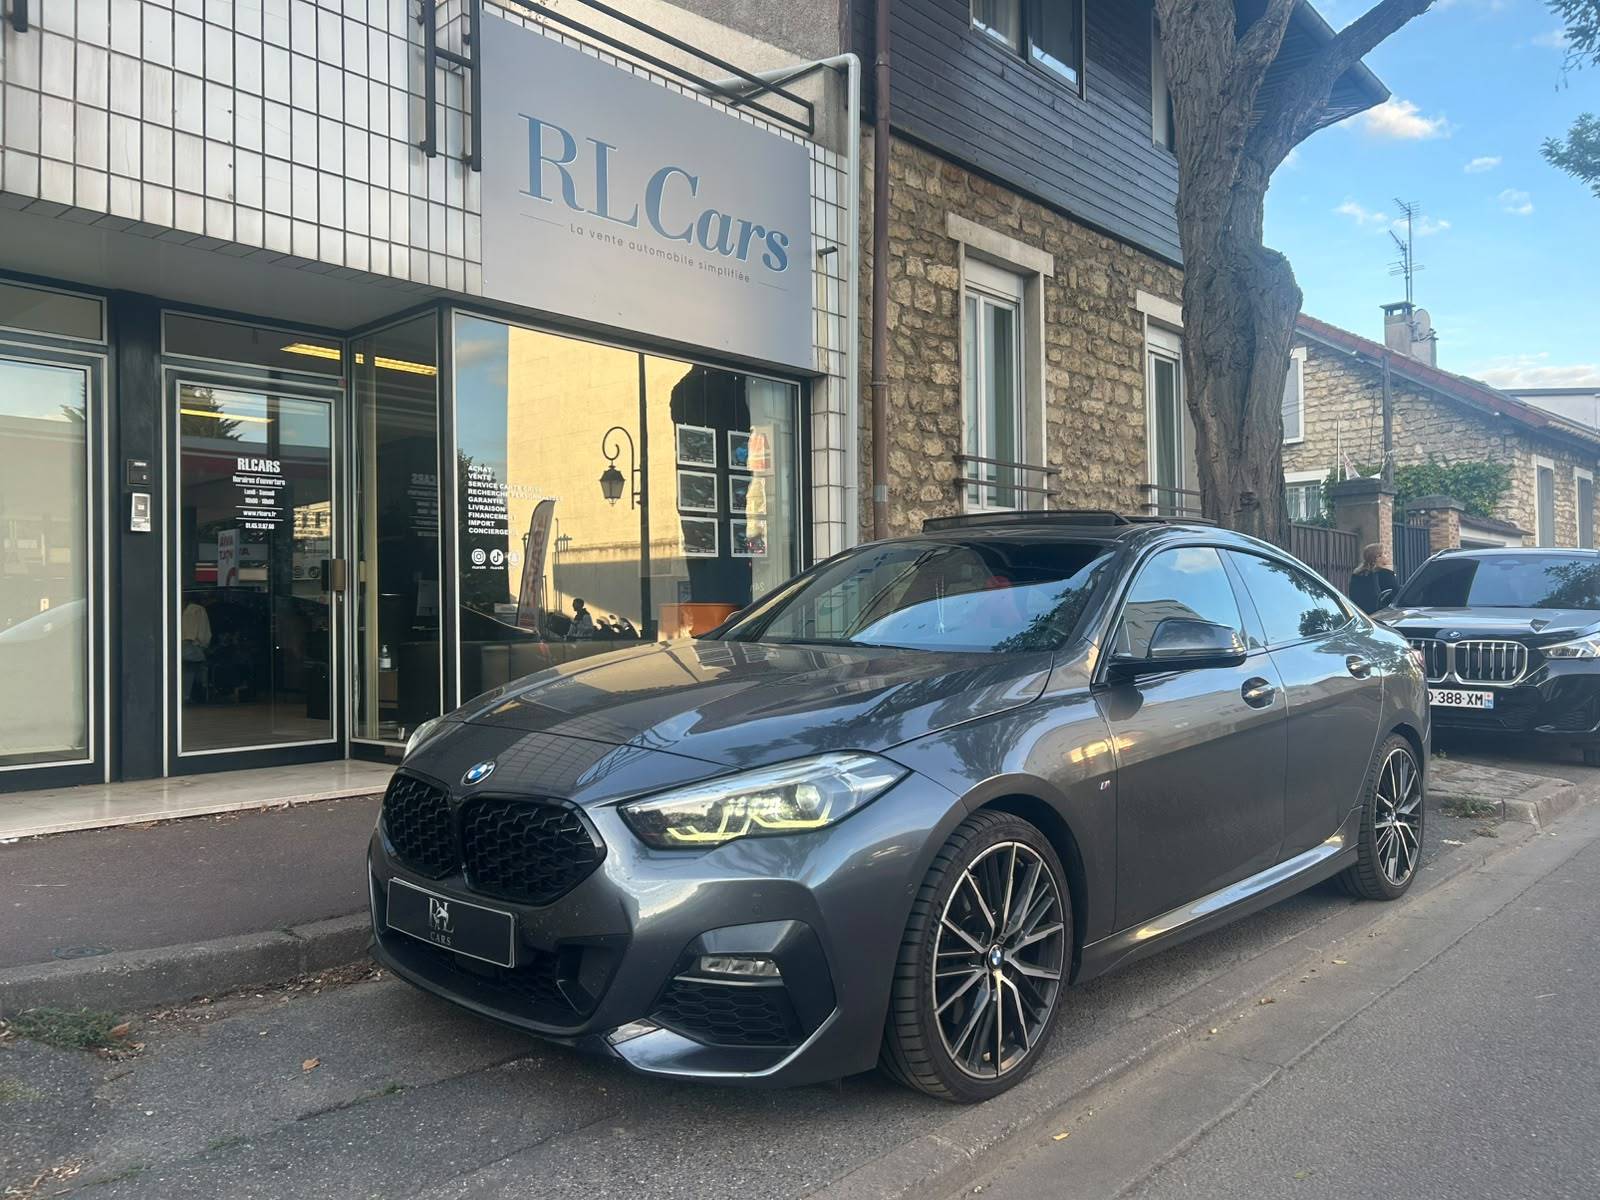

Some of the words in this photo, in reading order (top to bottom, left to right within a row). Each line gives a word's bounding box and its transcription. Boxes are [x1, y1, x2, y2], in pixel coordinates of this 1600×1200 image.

[569, 223, 584, 236] La
[589, 228, 625, 248] vente
[628, 240, 695, 268] automobile
[698, 261, 751, 284] simplifiée
[237, 458, 281, 473] RLCARS
[468, 465, 492, 474] ACHAT
[233, 475, 255, 484] Horaires
[256, 477, 286, 486] d'ouverture
[468, 473, 492, 482] VENTE
[468, 481, 499, 491] SERVICE
[468, 496, 504, 505] GARANTIE
[468, 504, 506, 513] LIVRAISON
[468, 520, 495, 528] IMPORT
[430, 932, 452, 946] CARS
